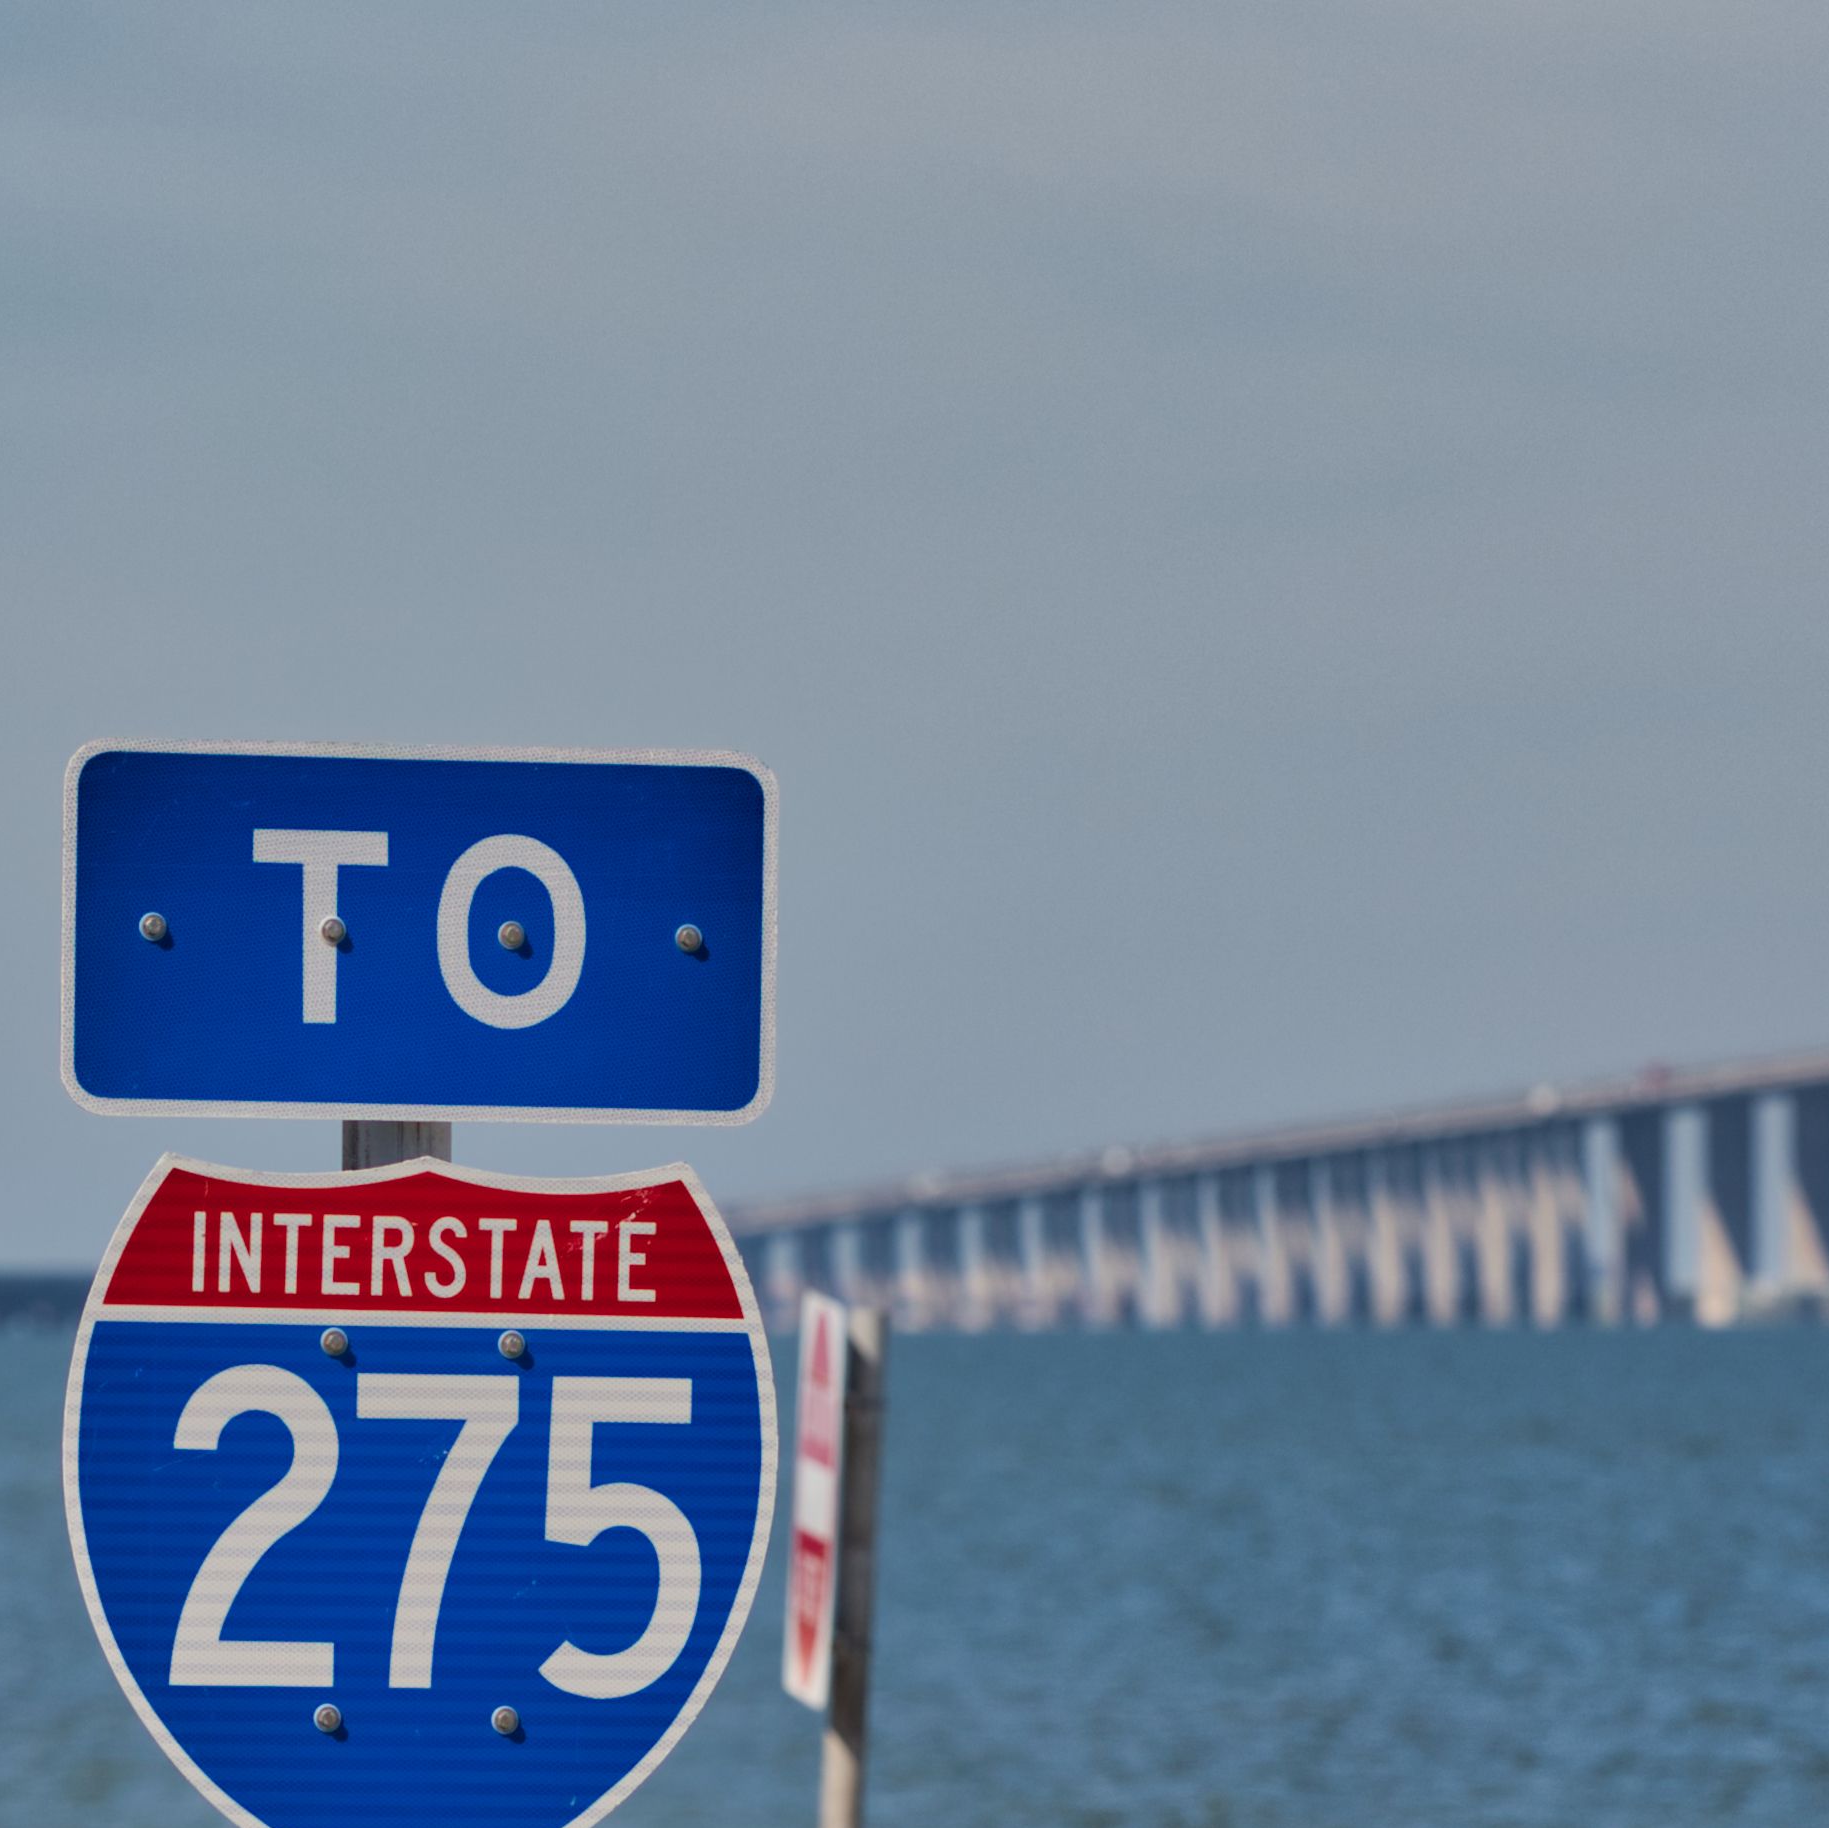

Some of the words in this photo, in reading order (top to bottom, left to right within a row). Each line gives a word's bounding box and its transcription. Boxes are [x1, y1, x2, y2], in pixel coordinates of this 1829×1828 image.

[252, 829, 586, 1029] TO
[192, 1211, 658, 1302] INTERSTATE
[168, 1364, 702, 1699] 275
